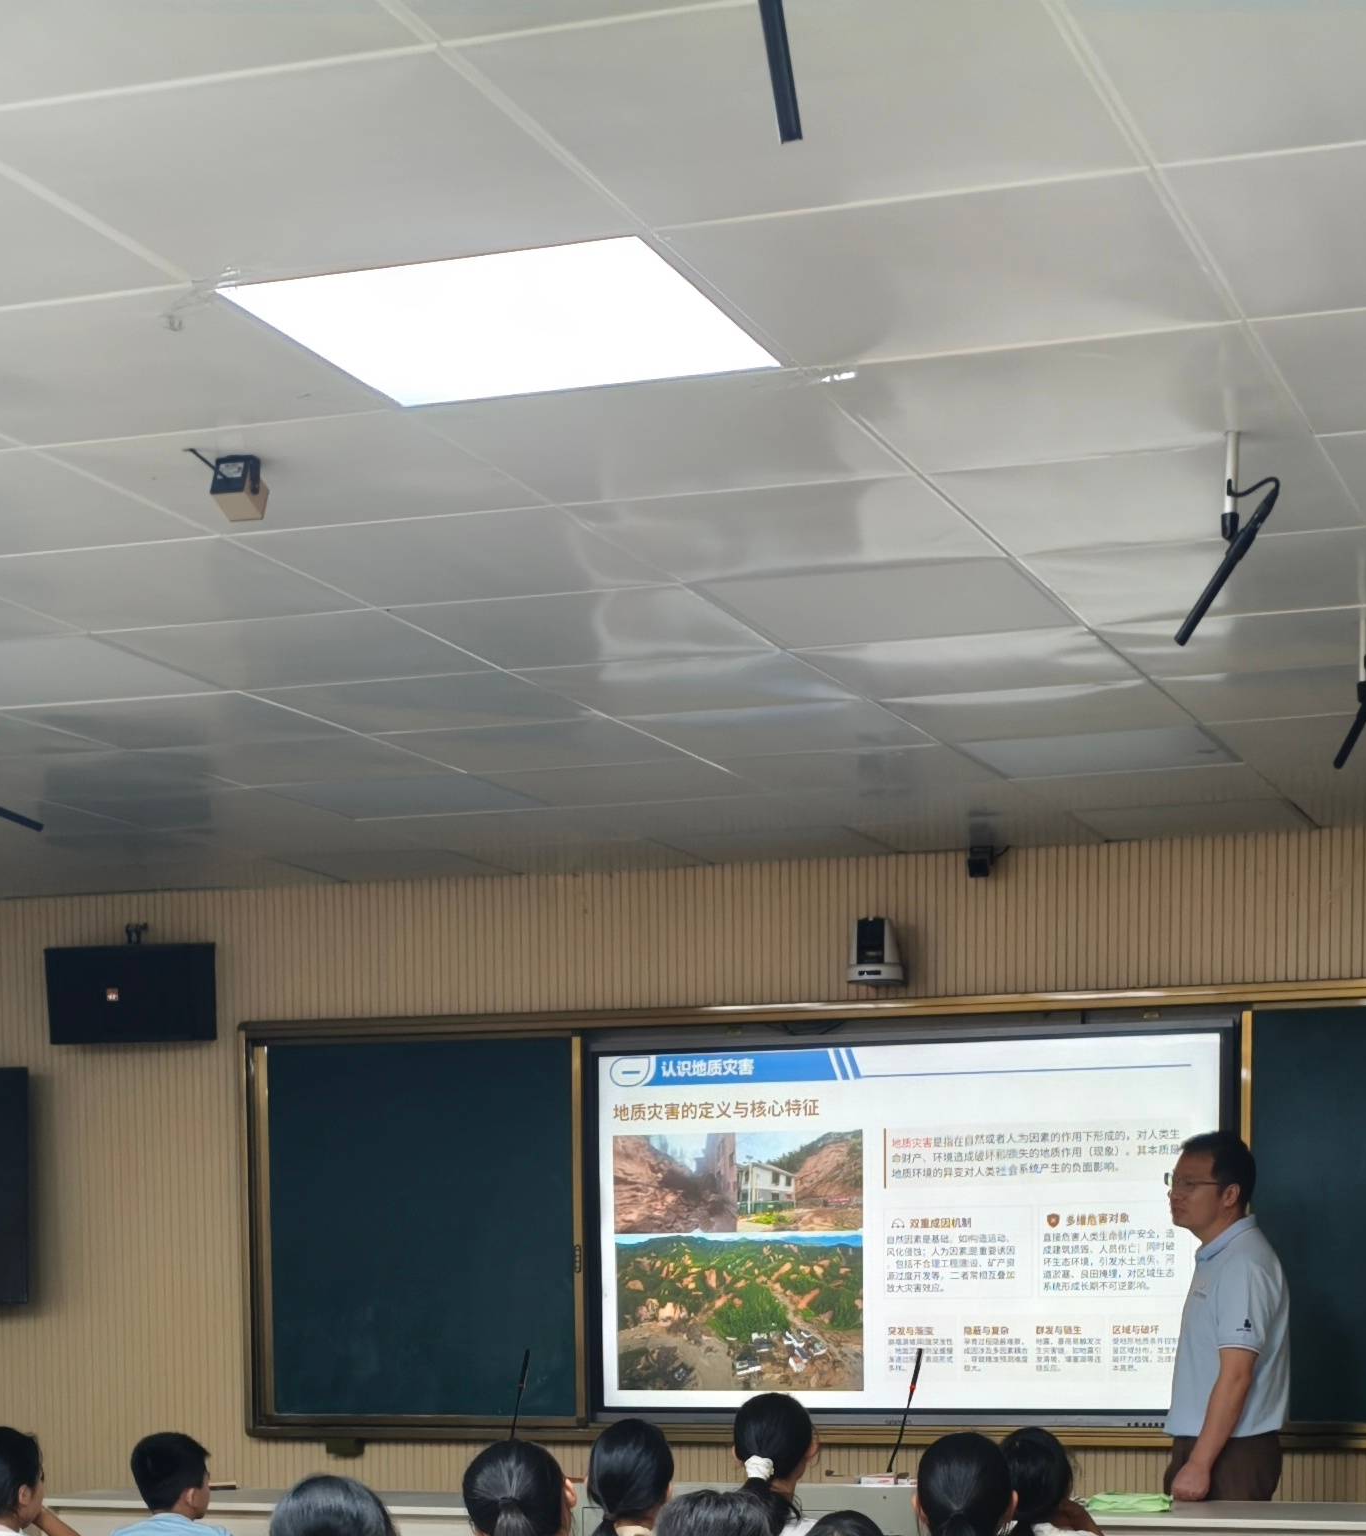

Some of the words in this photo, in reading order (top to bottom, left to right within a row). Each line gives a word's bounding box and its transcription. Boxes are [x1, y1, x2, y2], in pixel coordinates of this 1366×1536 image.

[661, 1058, 754, 1078] 认识地质灾害
[613, 1099, 819, 1121] 地质灾害的定义与核心特征
[910, 1217, 972, 1229] 双重成因机制
[1066, 1212, 1130, 1226] 多维危害对象
[1112, 1325, 1160, 1335] 区域与破坏
